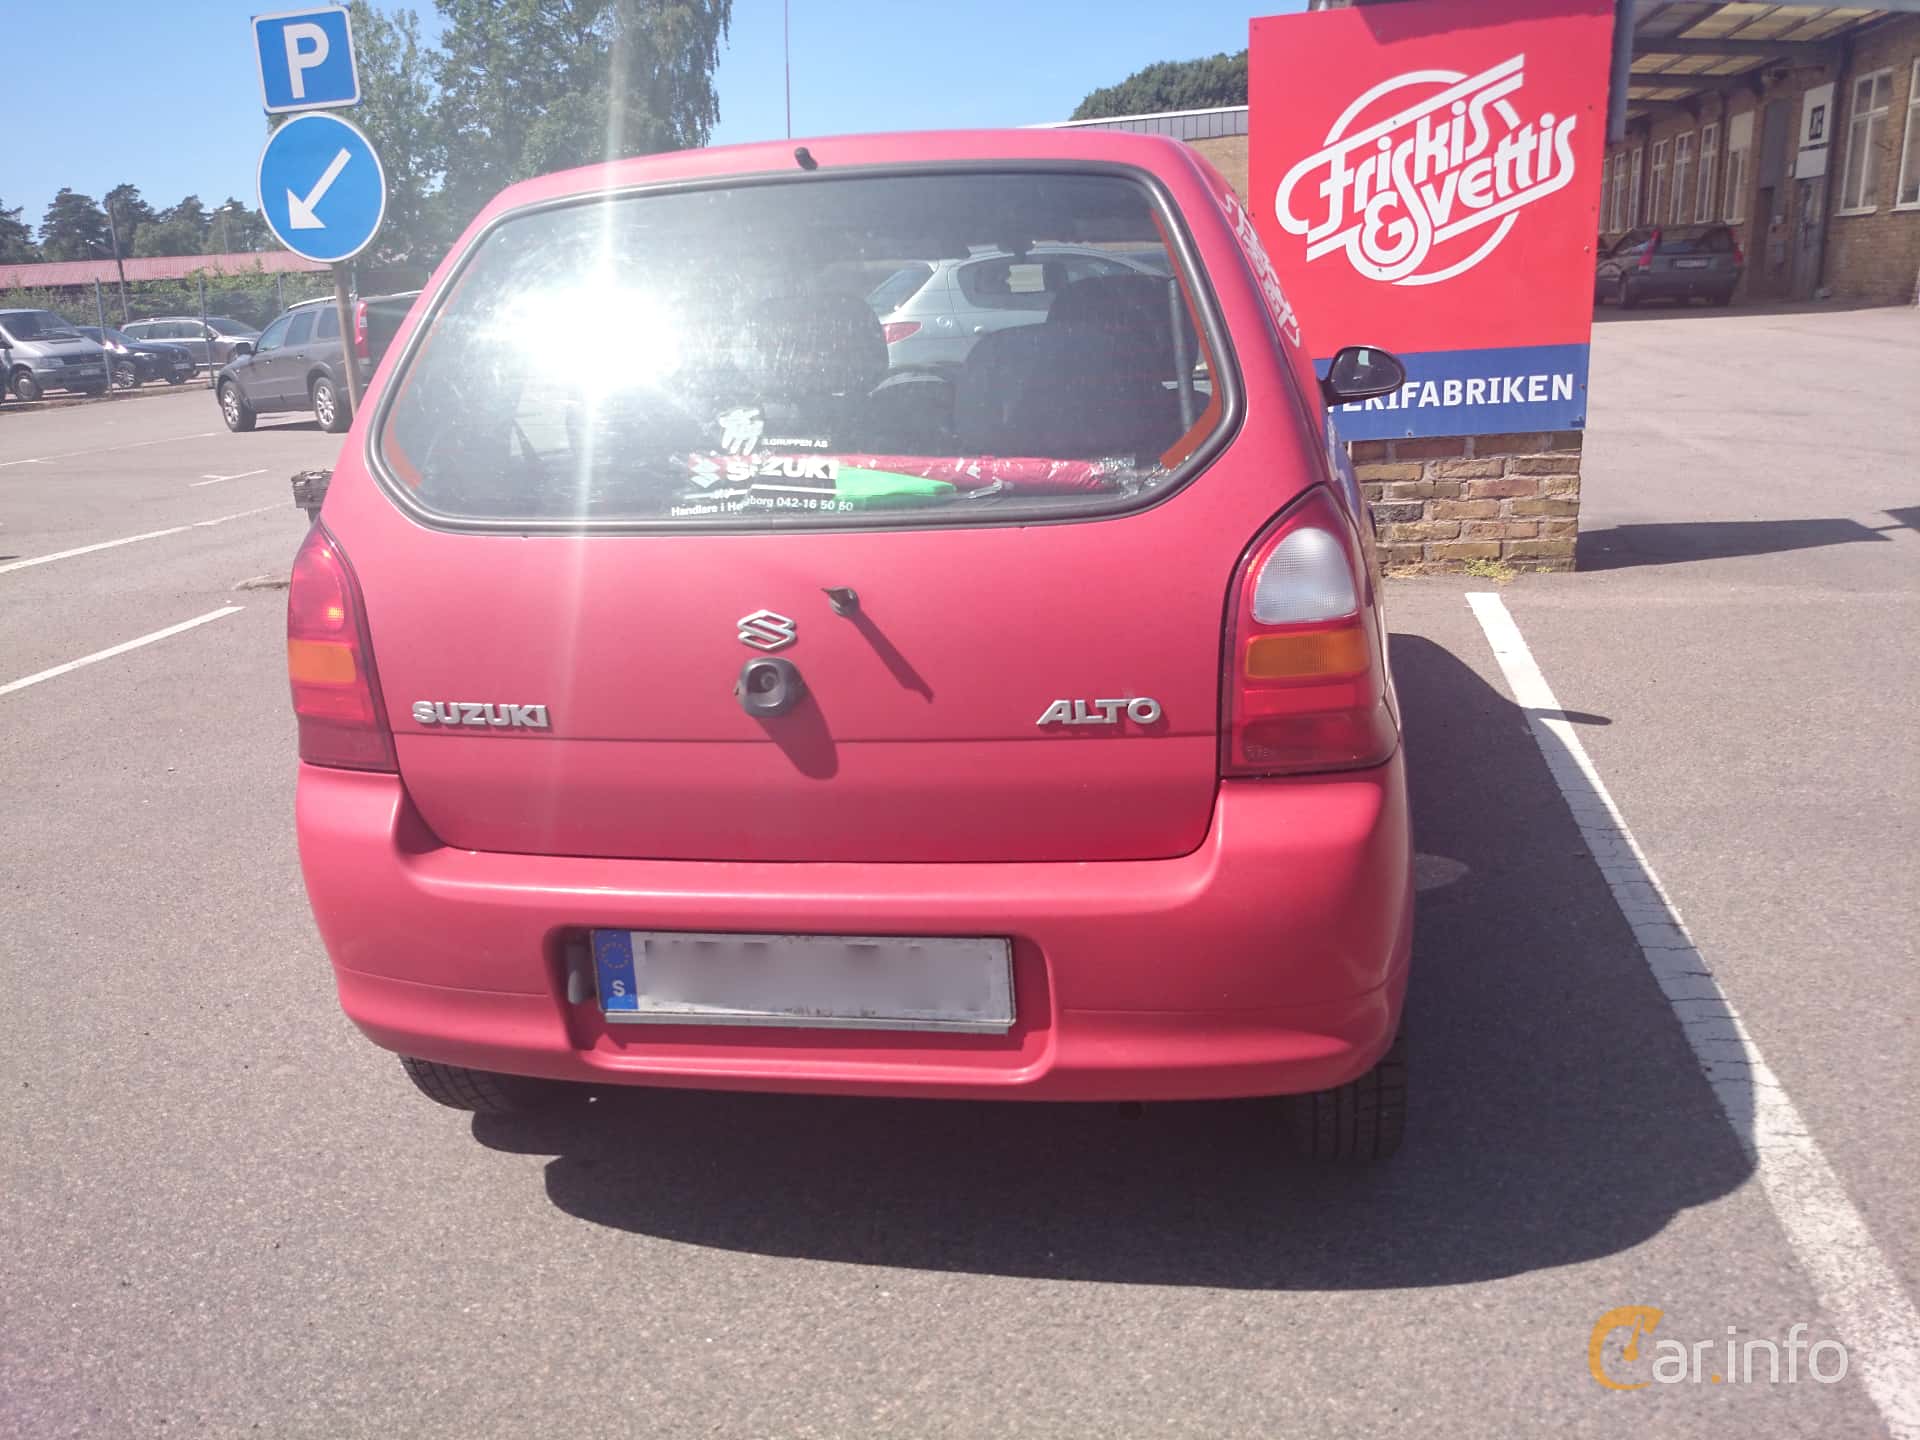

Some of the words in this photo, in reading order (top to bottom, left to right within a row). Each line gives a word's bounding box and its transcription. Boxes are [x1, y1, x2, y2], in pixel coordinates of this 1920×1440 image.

[283, 23, 329, 99] P
[1275, 53, 1524, 242] Friskis
[776, 496, 817, 509] 042-16
[820, 500, 835, 511] 50
[412, 700, 548, 727] SUZUKI
[1036, 697, 1161, 725] ALTO
[612, 980, 625, 997] S
